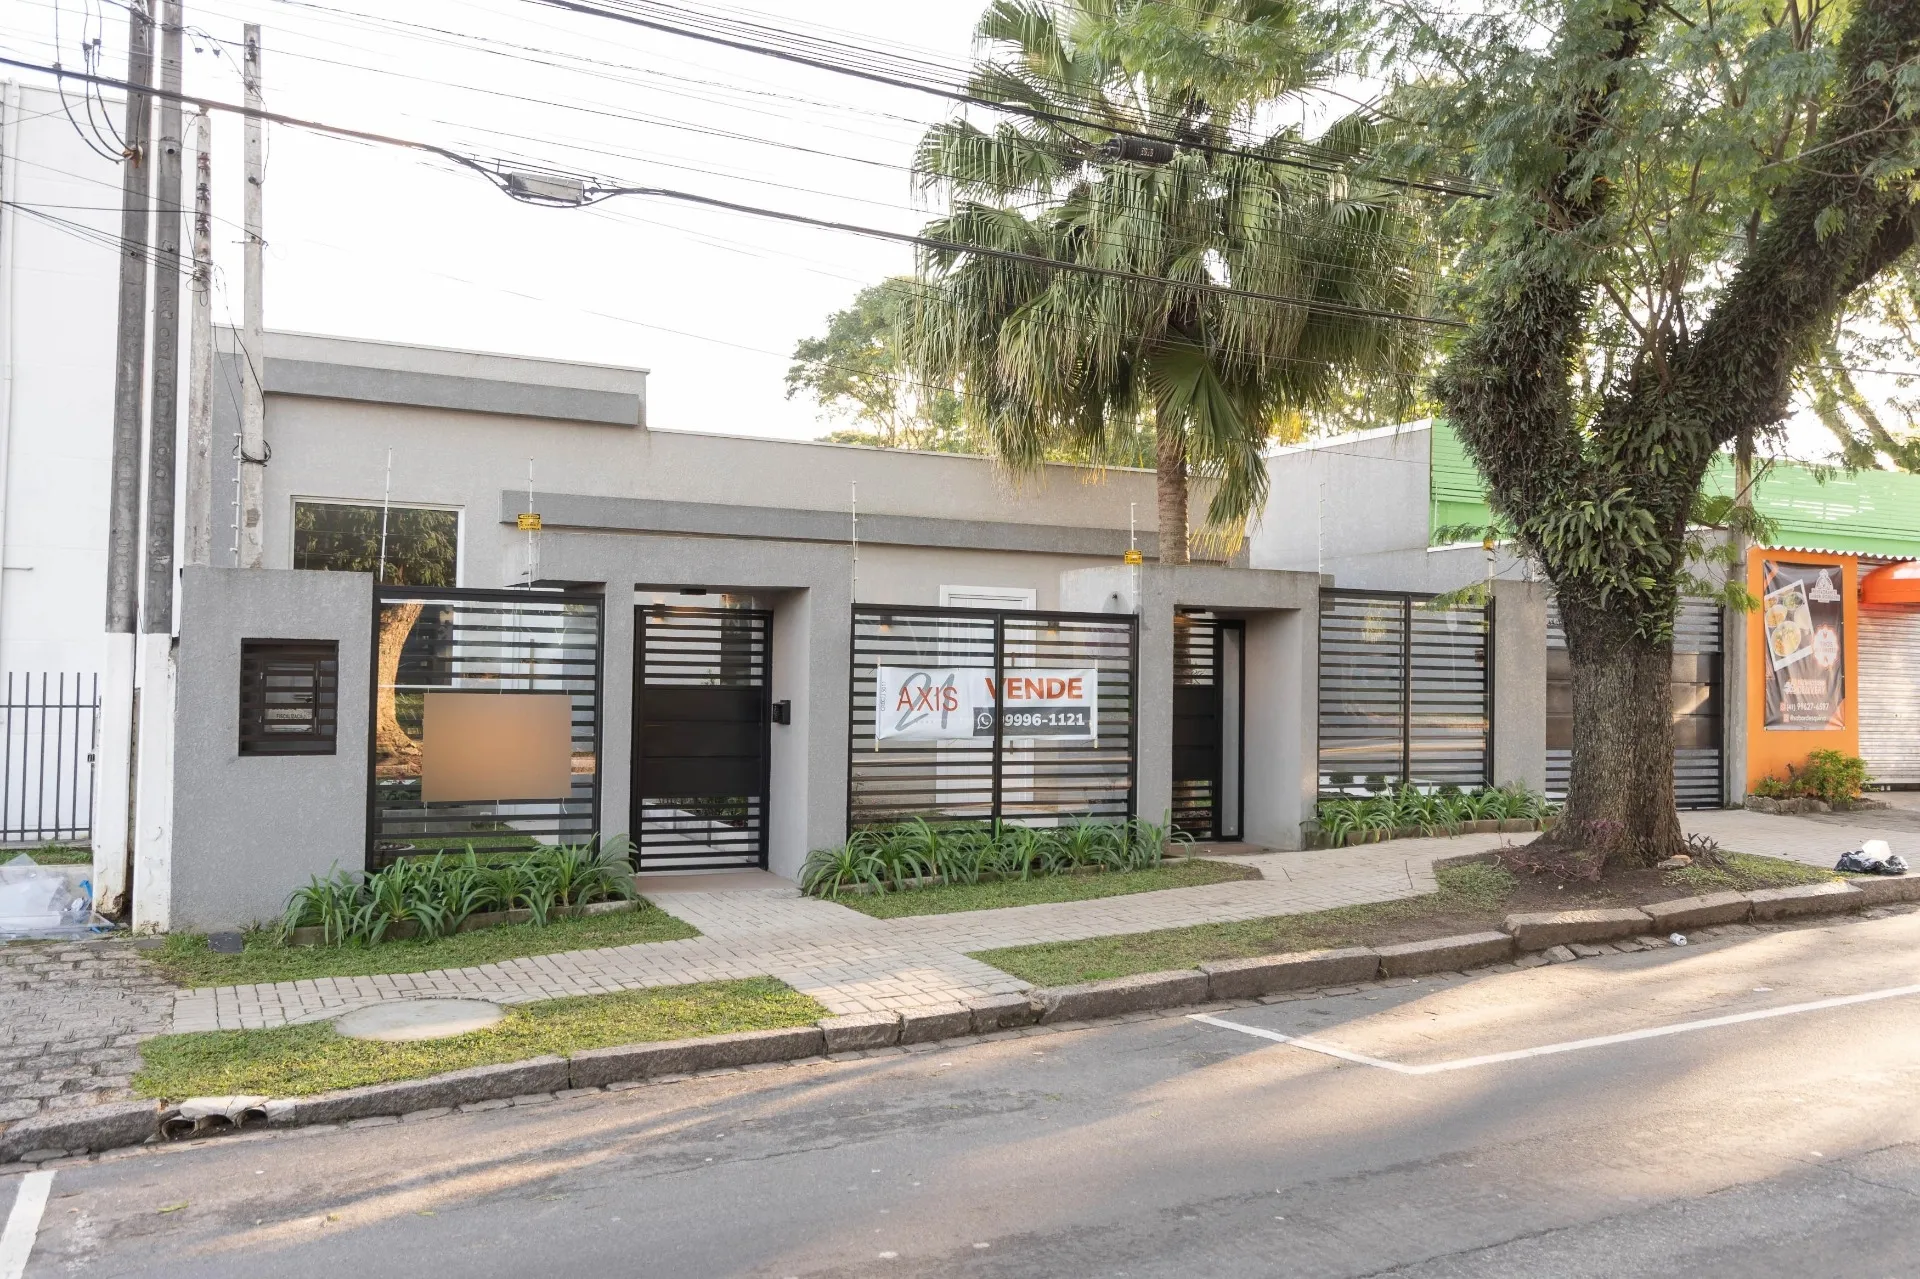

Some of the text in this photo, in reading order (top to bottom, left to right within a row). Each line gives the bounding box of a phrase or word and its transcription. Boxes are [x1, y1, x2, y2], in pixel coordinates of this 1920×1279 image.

[896, 687, 958, 711] AXIS
[984, 677, 1082, 699] VENDE
[1003, 713, 1085, 726] 9996-1121
